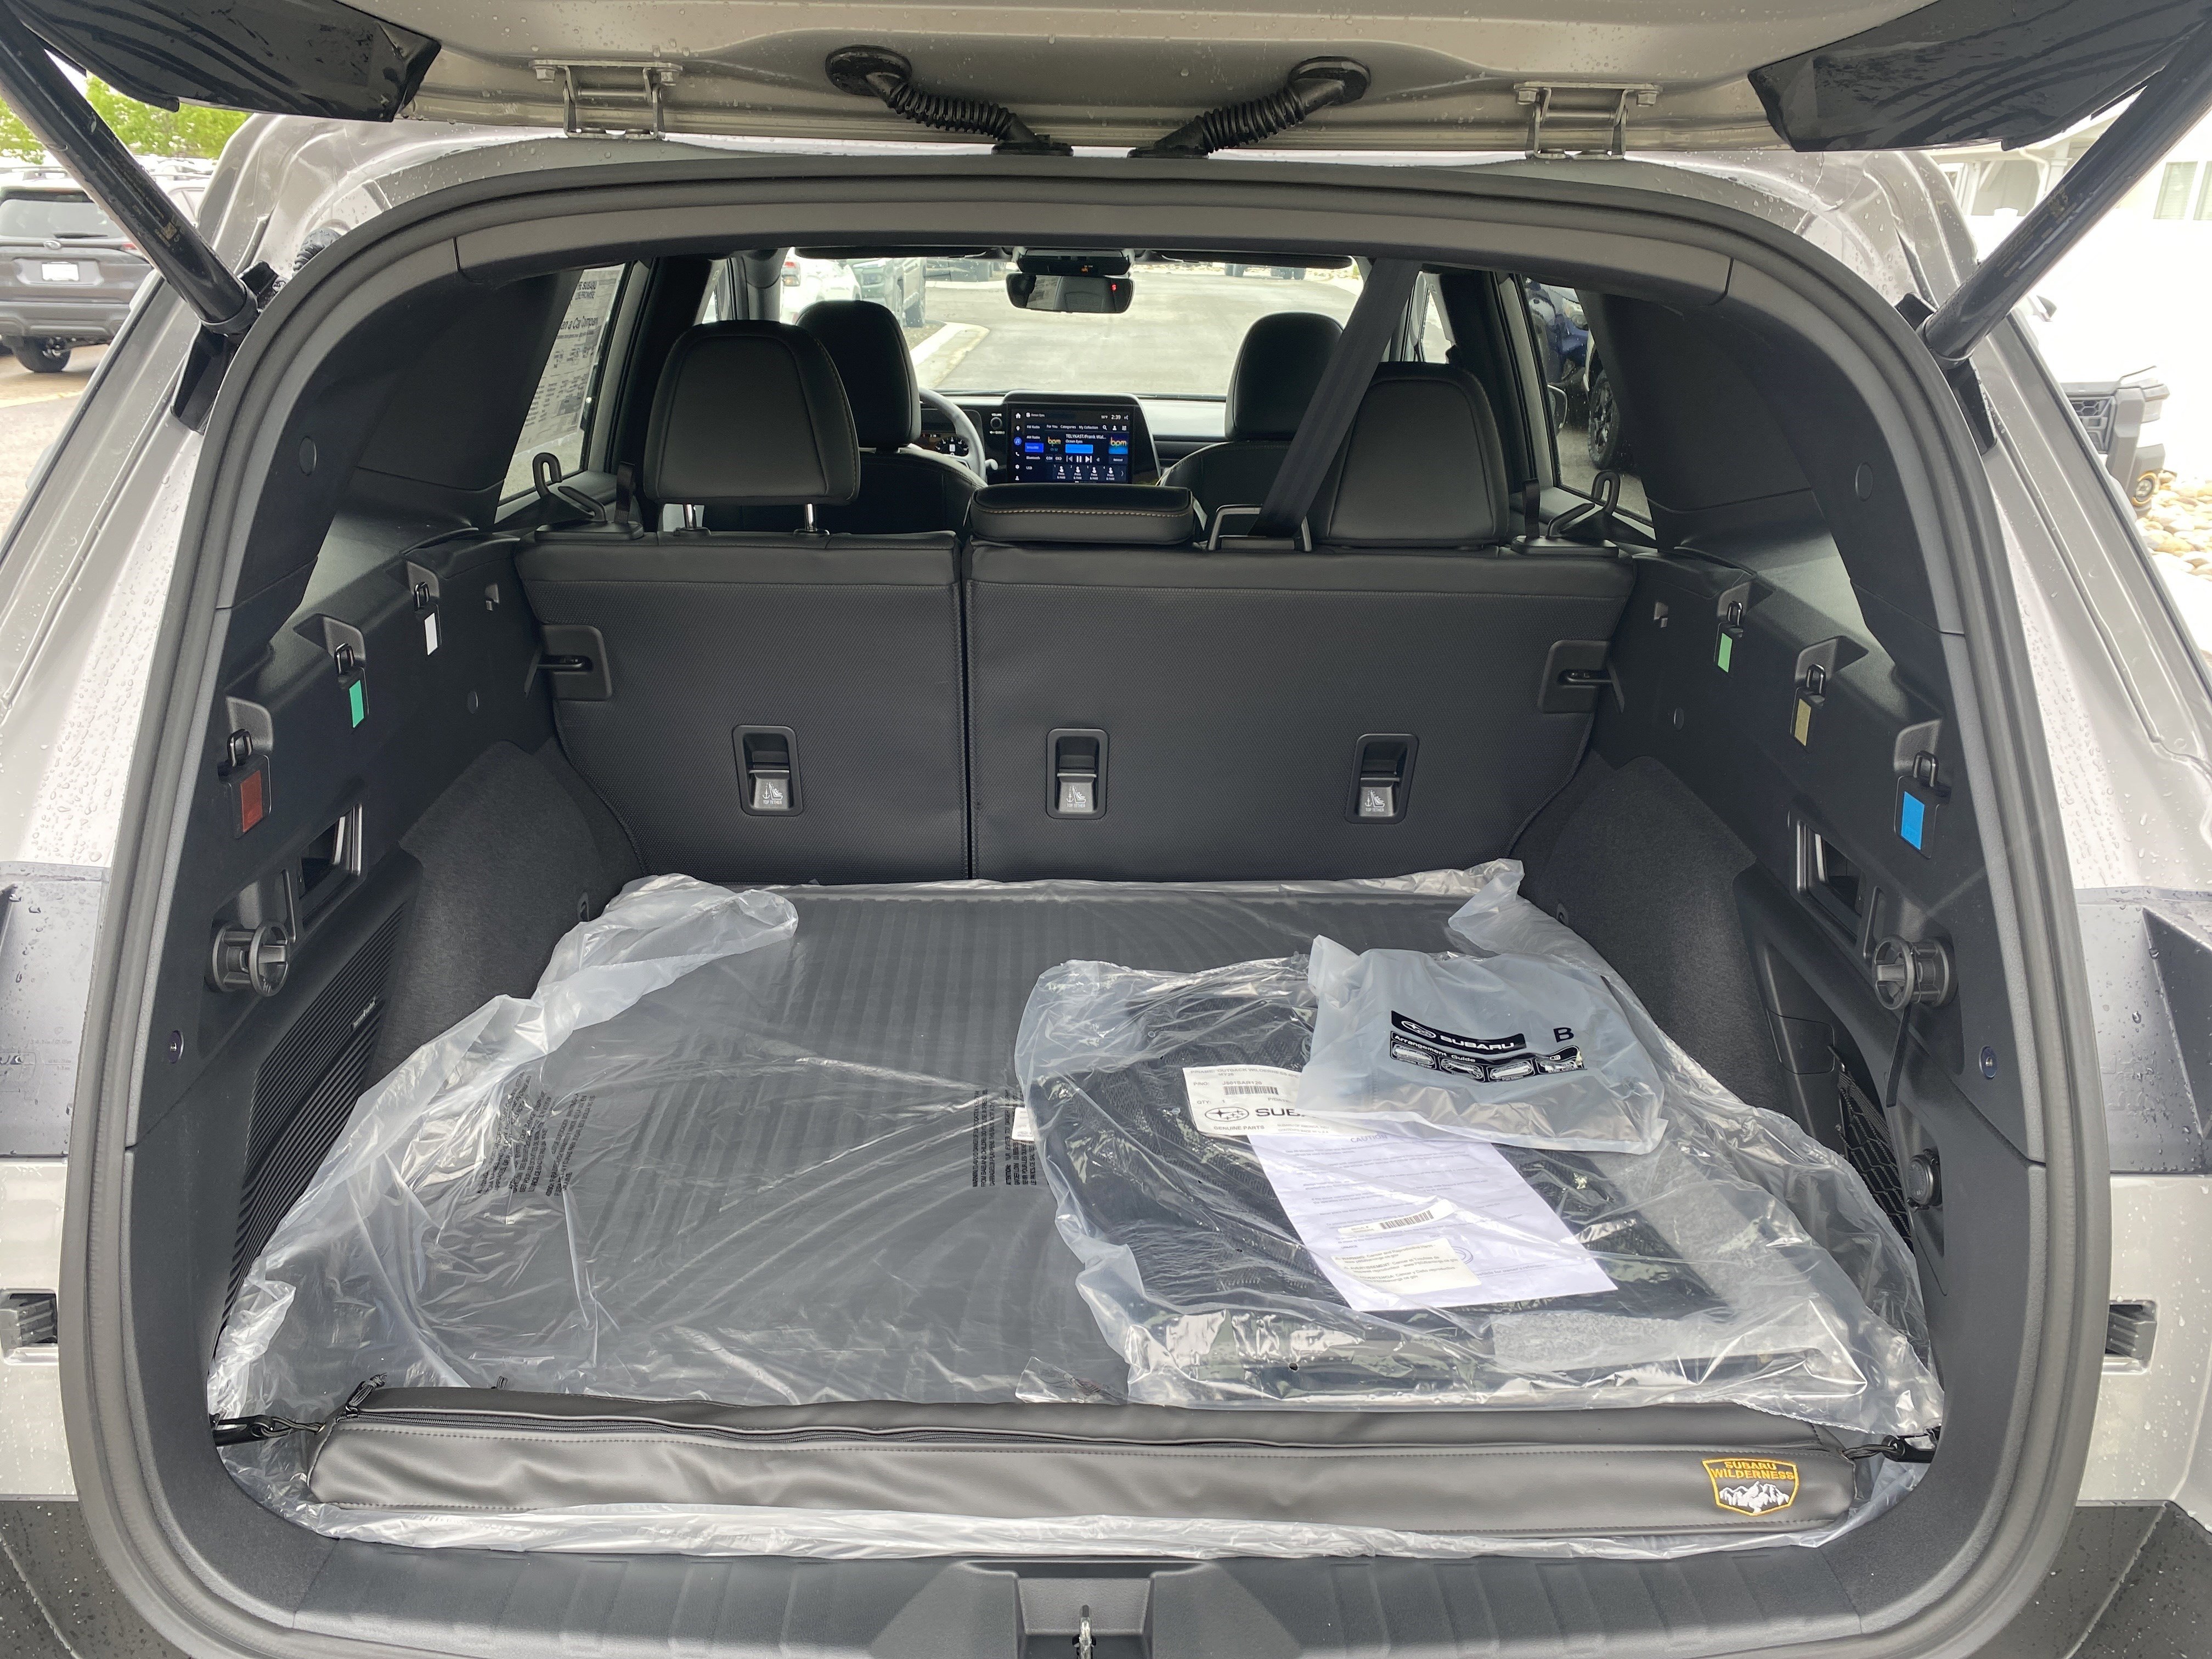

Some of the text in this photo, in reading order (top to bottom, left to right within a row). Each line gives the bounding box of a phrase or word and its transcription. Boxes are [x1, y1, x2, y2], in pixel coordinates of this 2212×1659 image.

[1554, 1027, 1575, 1043] B
[1440, 1035, 1515, 1050] SUBARU
[1395, 1035, 1476, 1063] Arrangement Guide
[1248, 1068, 1288, 1076] WILDERNESS
[1350, 1135, 1388, 1143] CAUTION
[1724, 1461, 1778, 1470] SUBARU
[1711, 1468, 1795, 1480] WILDERNESS
